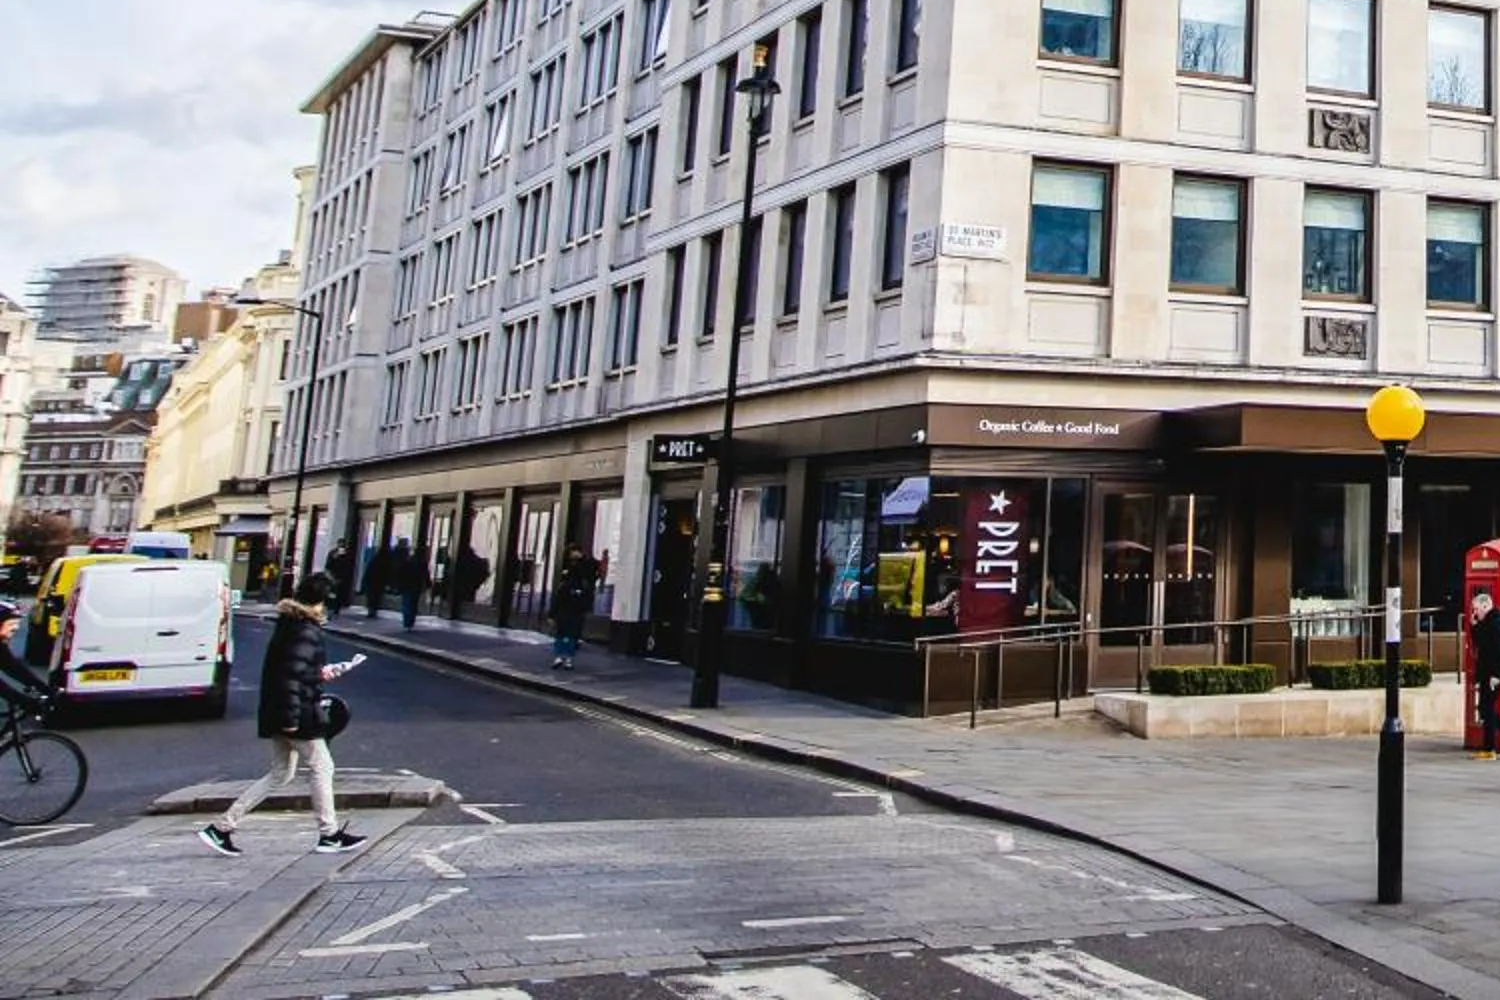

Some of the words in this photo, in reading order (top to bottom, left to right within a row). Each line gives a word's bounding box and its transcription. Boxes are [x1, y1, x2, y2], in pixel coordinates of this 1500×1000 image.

[980, 419, 1020, 433] Organic
[1021, 420, 1054, 433] Coffee
[1064, 421, 1092, 434] Good
[1094, 423, 1120, 435] Food
[669, 441, 696, 457] PRET
[975, 521, 1020, 594] PRET
